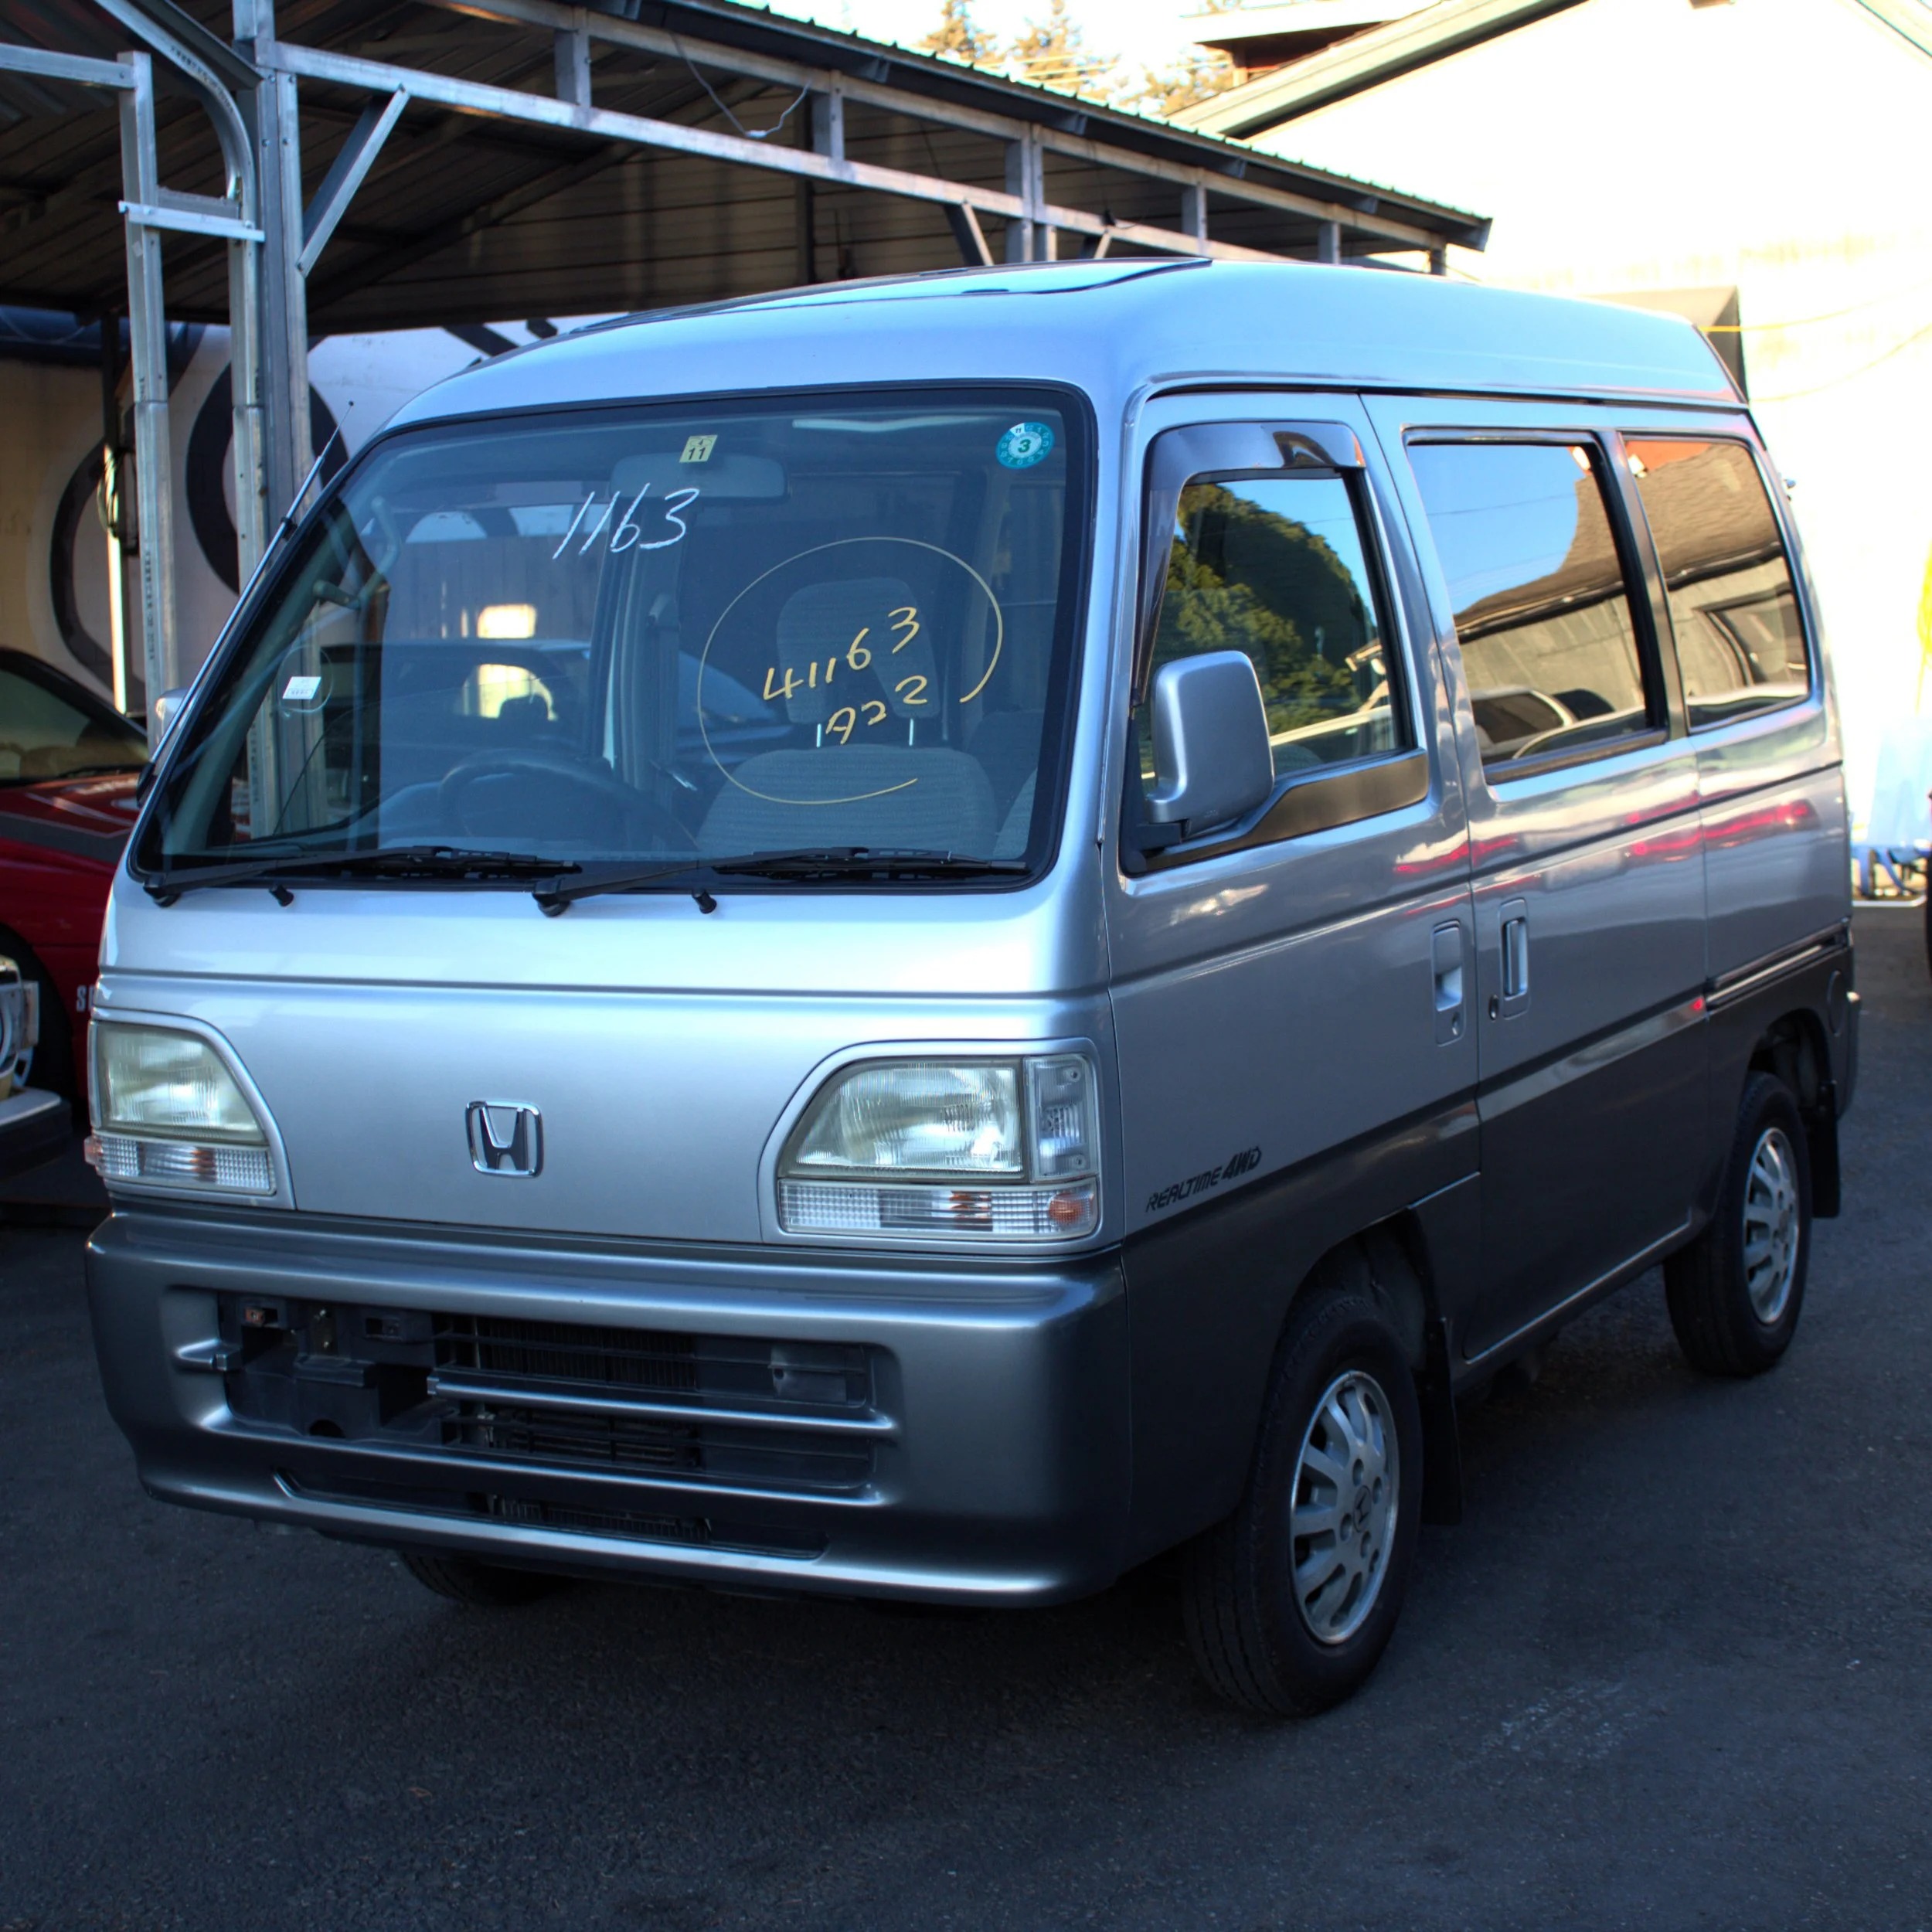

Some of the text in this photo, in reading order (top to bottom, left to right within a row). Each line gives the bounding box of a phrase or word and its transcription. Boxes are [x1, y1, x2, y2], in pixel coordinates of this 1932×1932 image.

[689, 447, 706, 461] 11
[1018, 439, 1032, 453] 3
[552, 481, 701, 560] 1163
[1145, 1145, 1263, 1213] REALTIME 4WD
